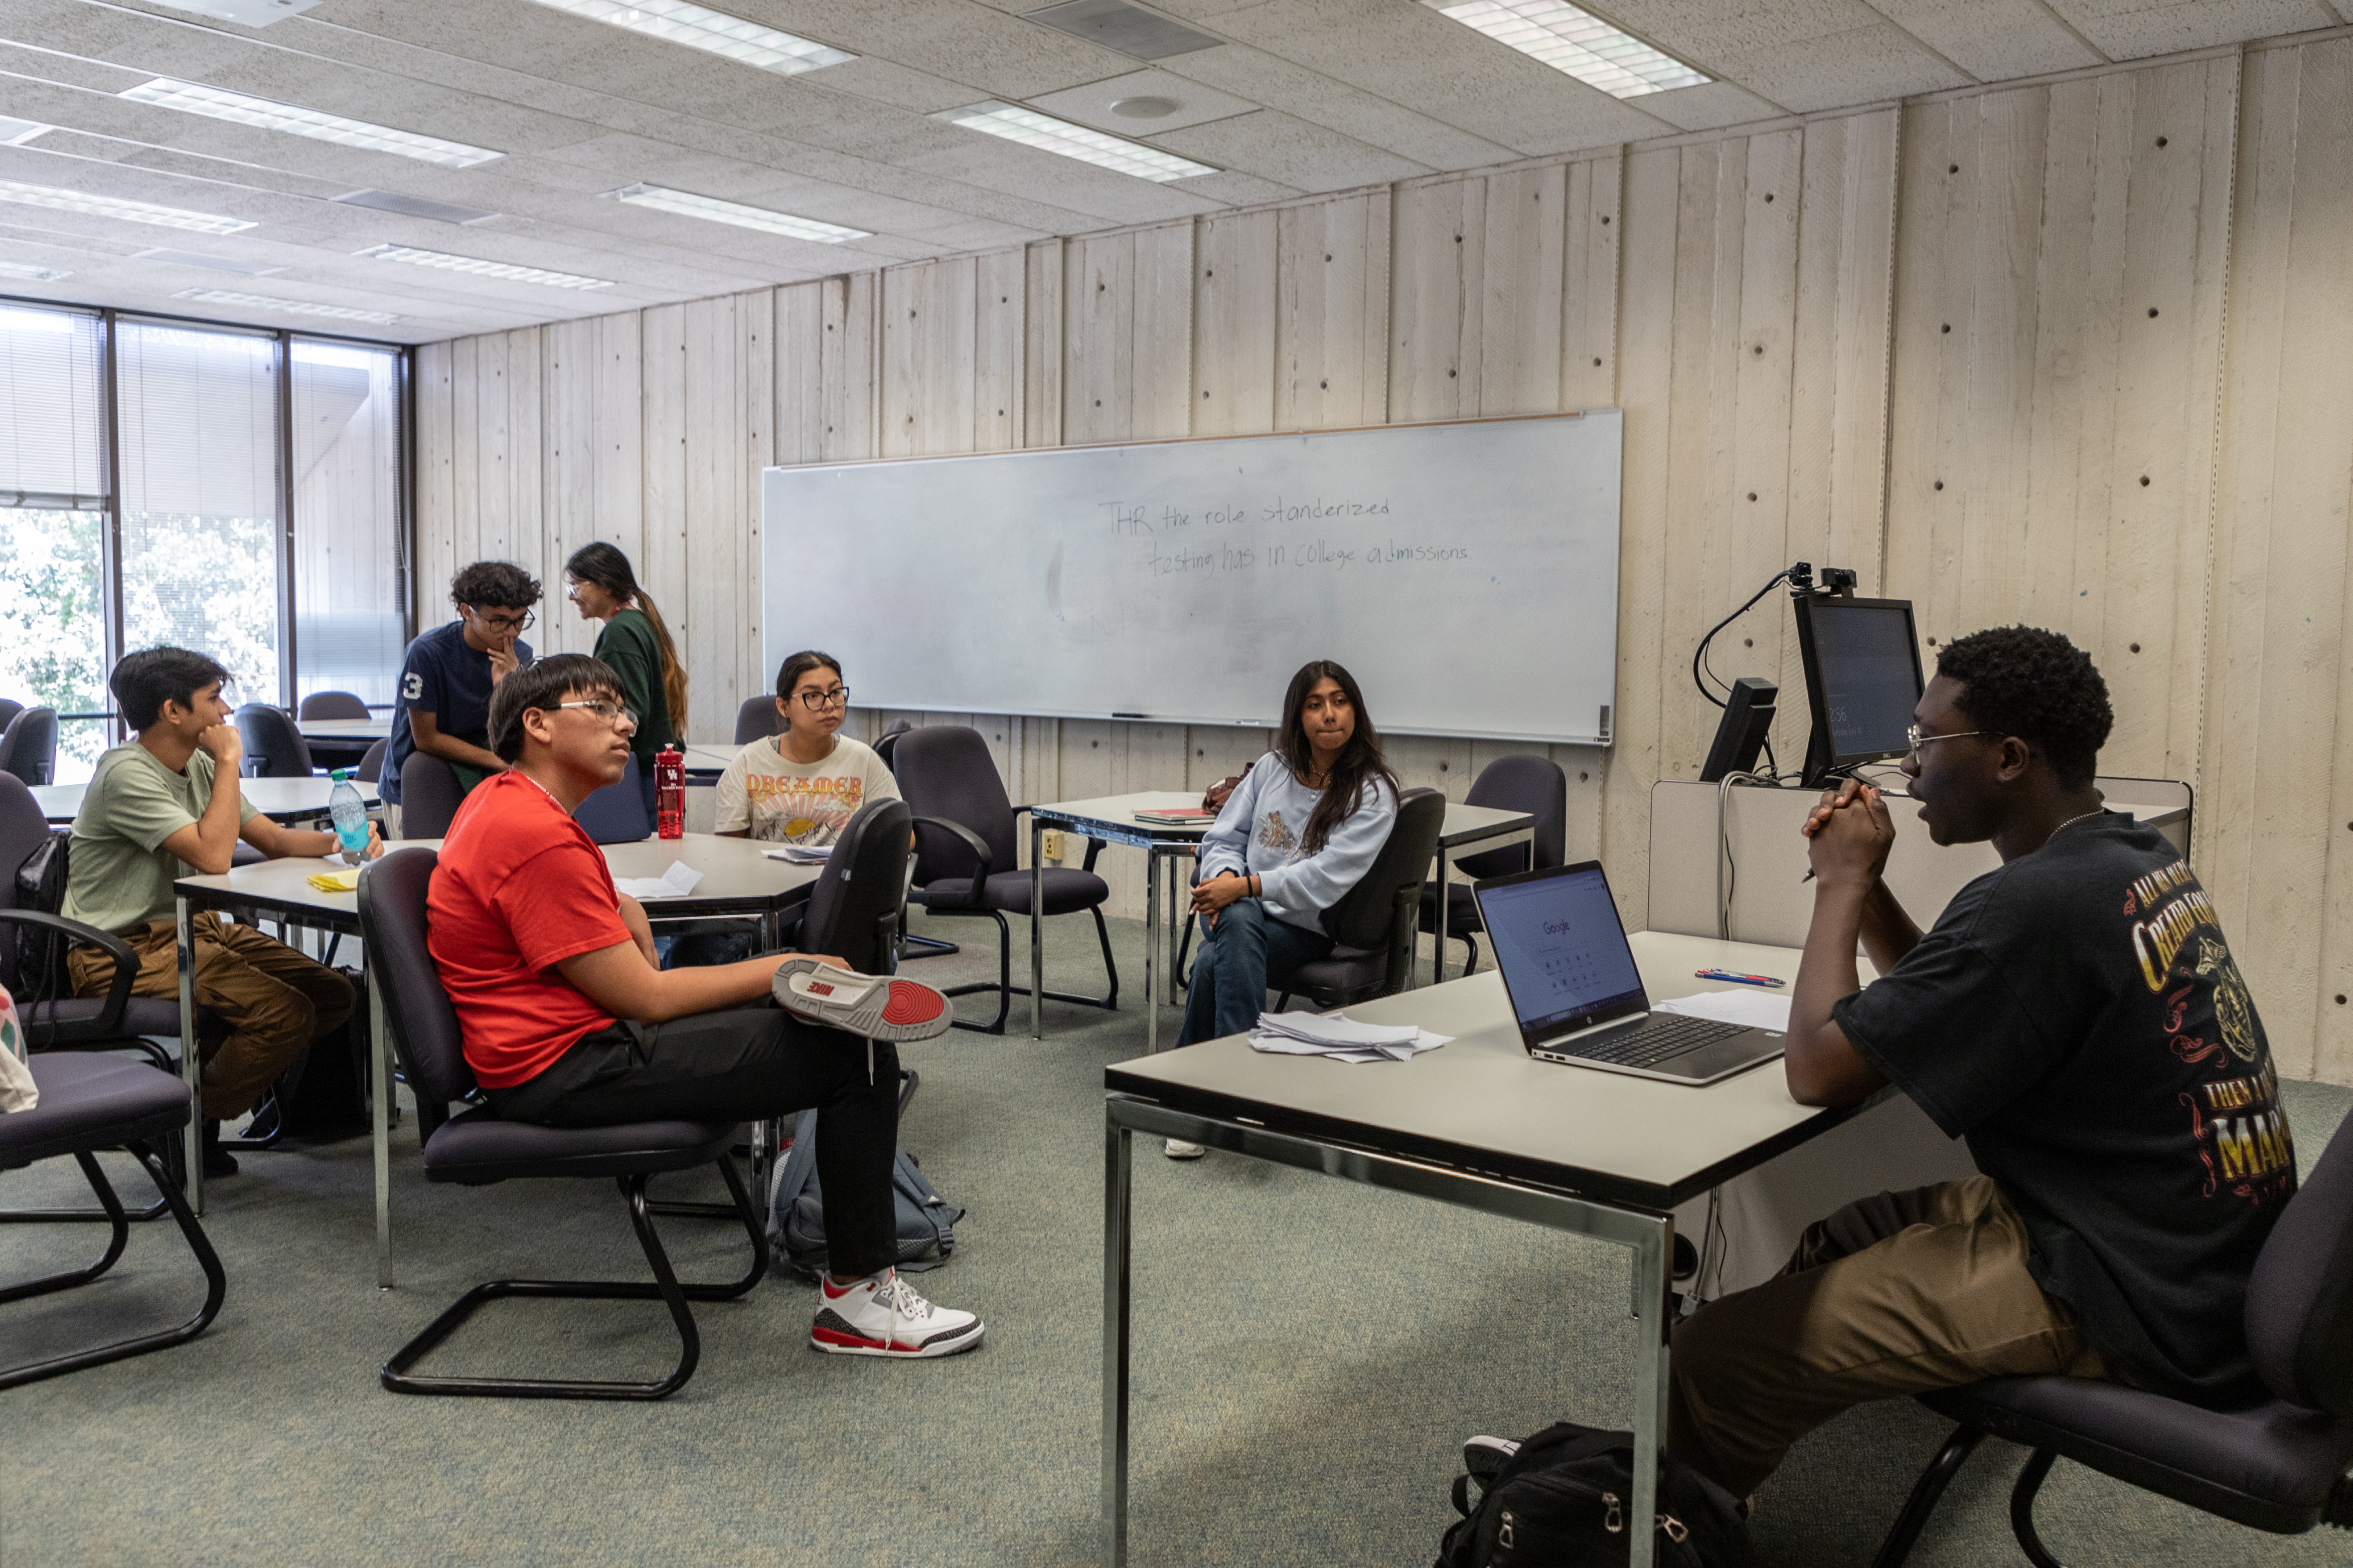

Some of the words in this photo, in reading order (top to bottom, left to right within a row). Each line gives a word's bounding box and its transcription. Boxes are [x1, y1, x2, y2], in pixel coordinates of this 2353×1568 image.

[1161, 504, 1190, 530] the
[1205, 503, 1246, 524] role
[1262, 495, 1389, 522] standerized
[1149, 541, 1214, 579] testing
[1222, 542, 1254, 571] has
[403, 672, 423, 700] 3
[747, 773, 863, 797] DREAMER
[2133, 876, 2159, 910] ALL
[1542, 919, 1570, 935] Google
[807, 981, 835, 997] NIKE
